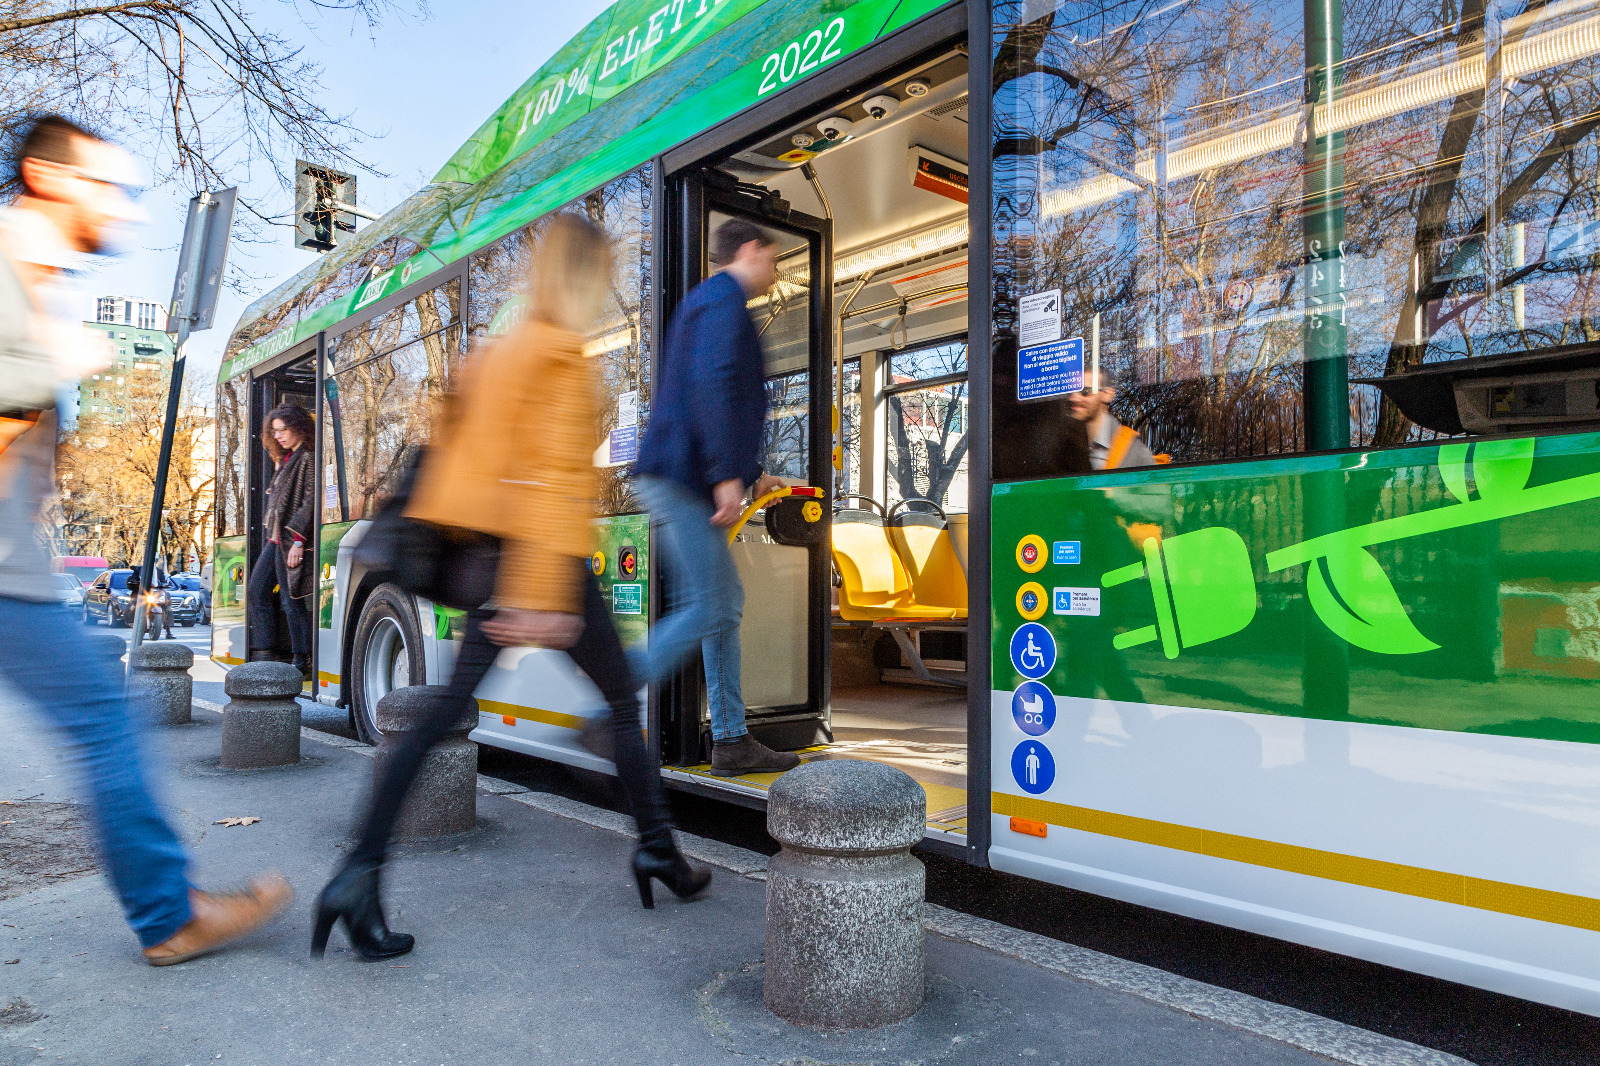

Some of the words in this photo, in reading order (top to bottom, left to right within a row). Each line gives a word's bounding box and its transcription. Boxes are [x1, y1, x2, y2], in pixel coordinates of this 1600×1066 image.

[517, 59, 591, 137] 100%
[598, 0, 724, 81] ELET
[757, 17, 845, 96] 2022
[1037, 353, 1054, 361] viaggio
[1054, 350, 1069, 358] valido
[1049, 343, 1076, 353] documento
